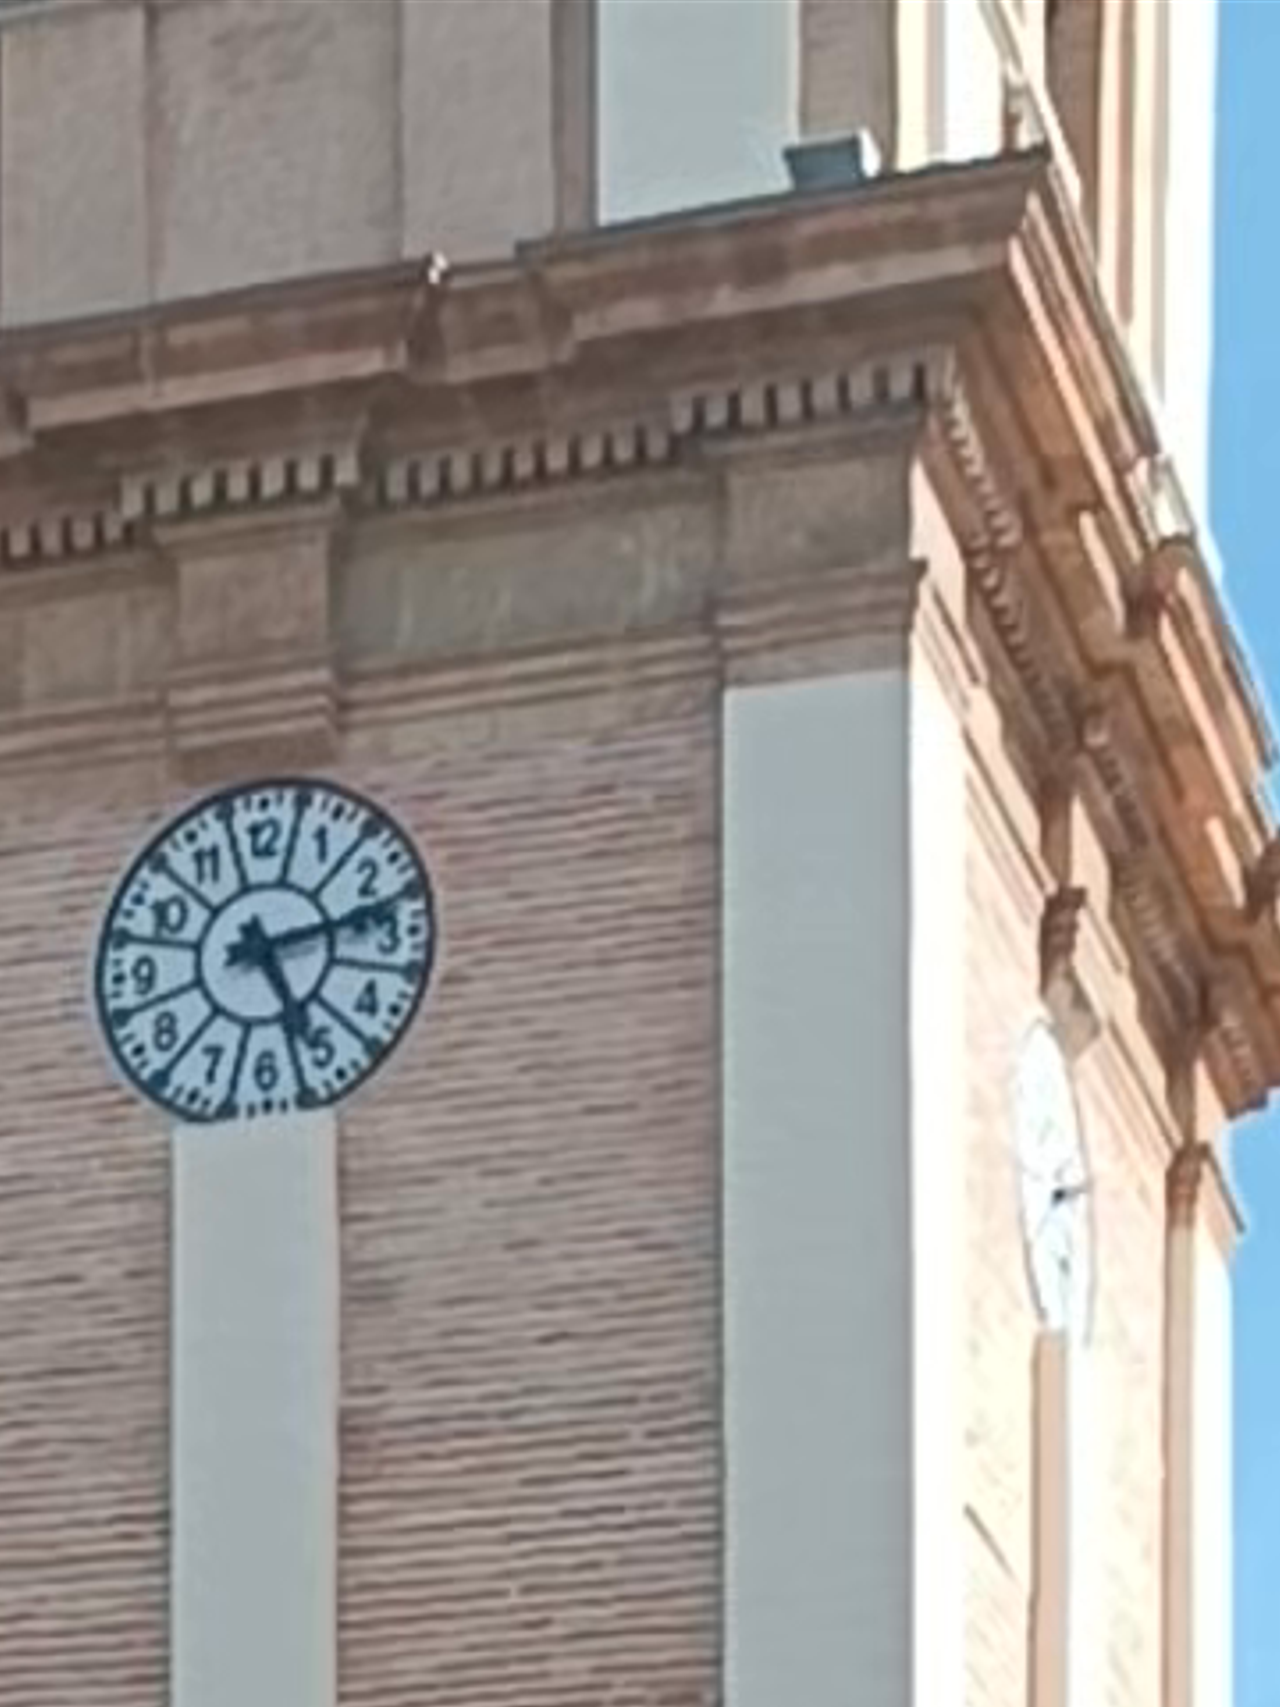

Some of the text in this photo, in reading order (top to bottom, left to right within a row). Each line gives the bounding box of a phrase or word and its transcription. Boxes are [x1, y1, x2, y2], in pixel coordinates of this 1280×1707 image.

[247, 818, 280, 857] 12
[313, 825, 326, 862] 1
[193, 846, 220, 884] 11
[356, 859, 379, 896] 2
[154, 896, 187, 937] 10
[376, 909, 399, 954] 3
[131, 956, 155, 994] 9
[354, 979, 378, 1017] 4
[154, 1012, 178, 1051] 8
[310, 1027, 335, 1068] 5
[203, 1048, 223, 1084] 7
[254, 1051, 277, 1088] 6
